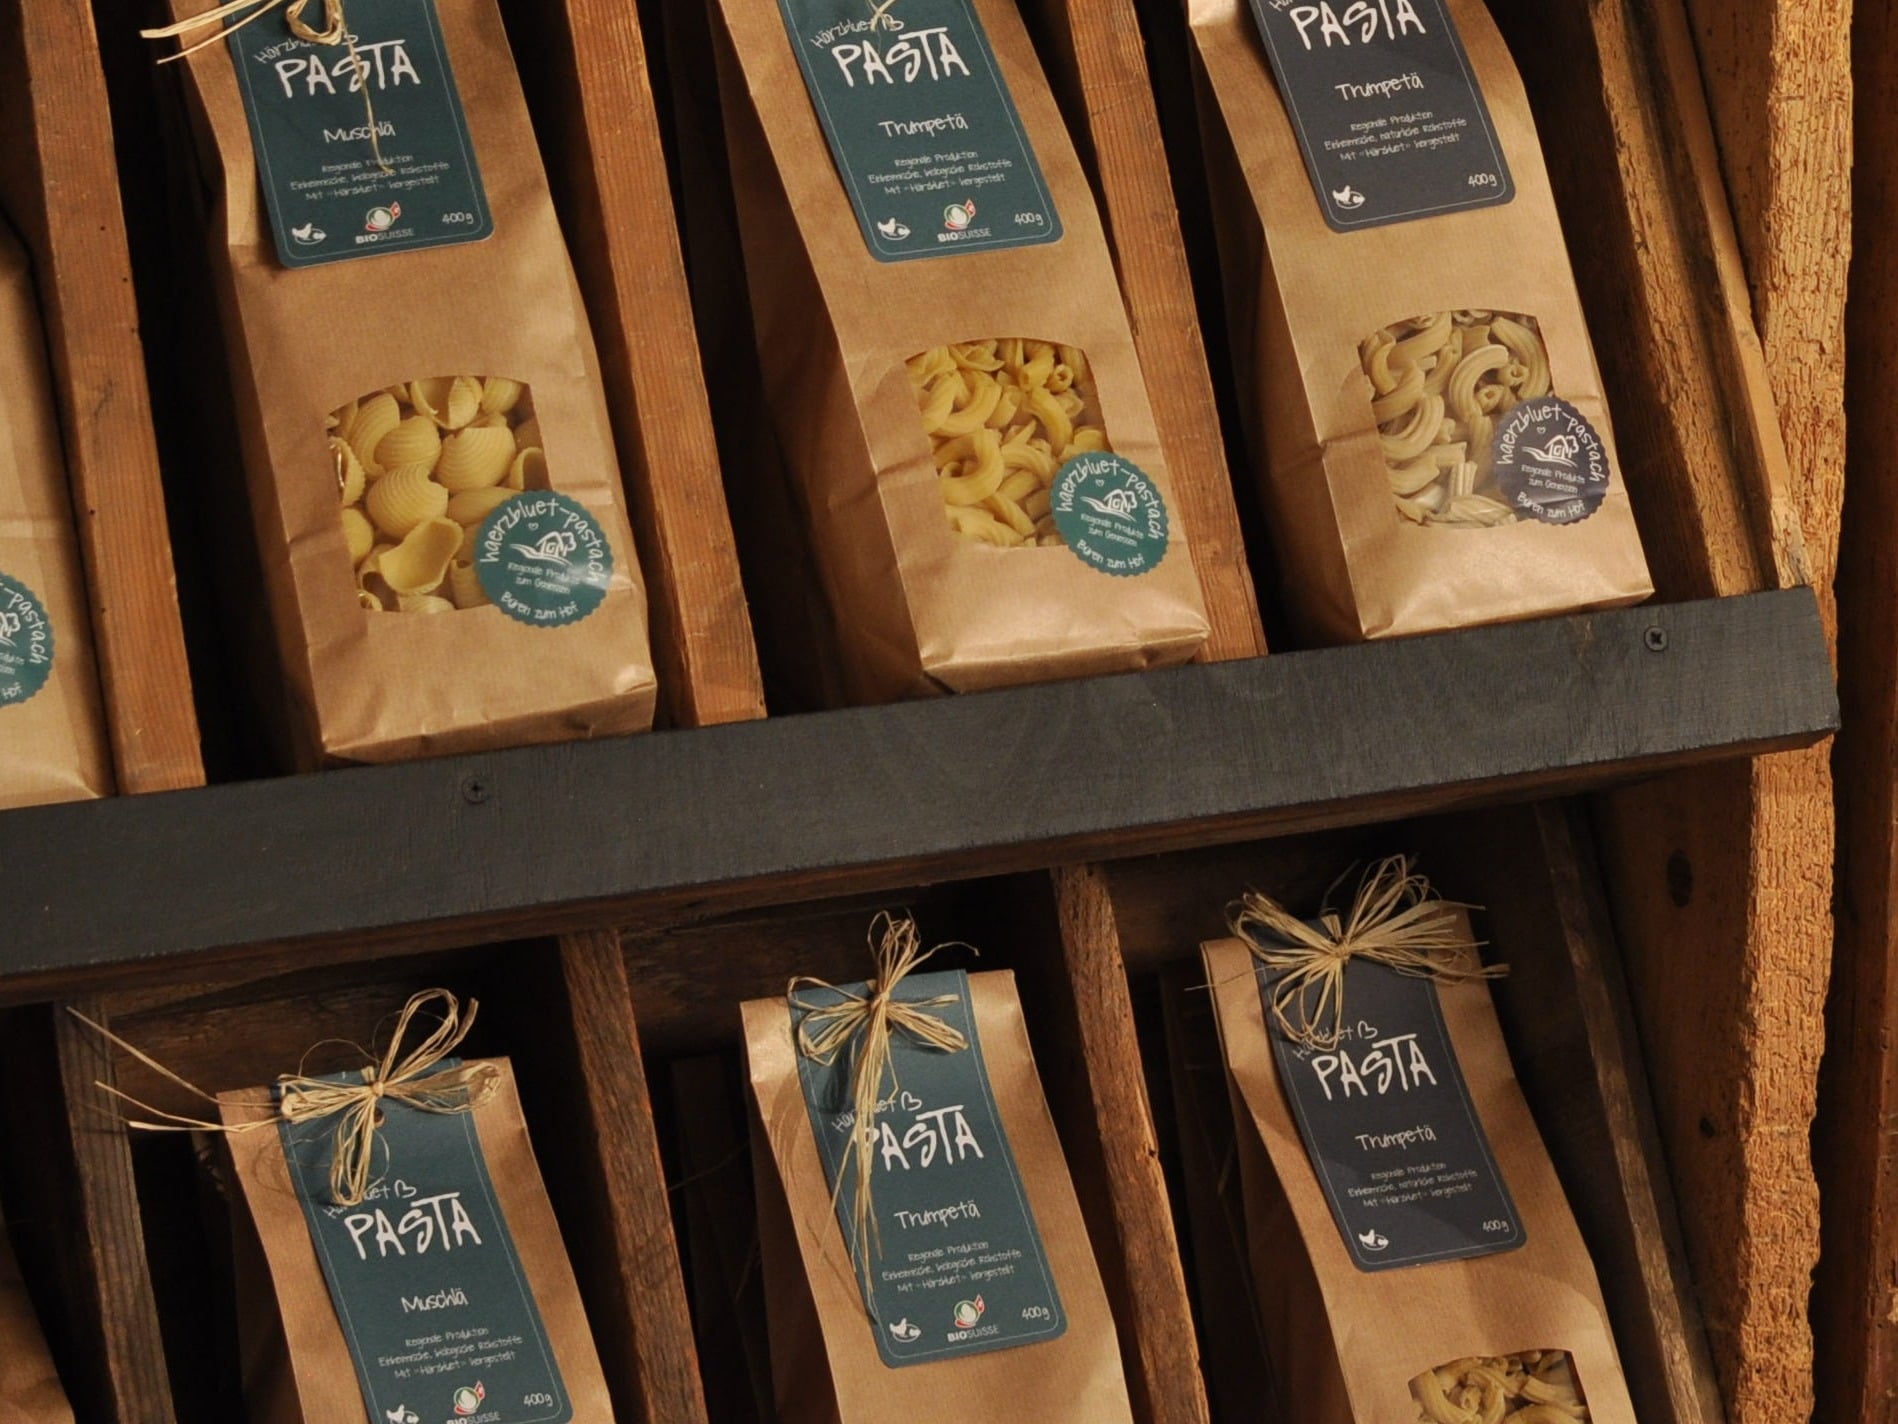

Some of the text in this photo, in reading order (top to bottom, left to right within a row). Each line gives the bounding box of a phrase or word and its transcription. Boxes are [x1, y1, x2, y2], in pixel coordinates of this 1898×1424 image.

[275, 39, 421, 98] PASTA
[832, 27, 970, 87] PASTA
[1335, 72, 1424, 101] Trumpetä
[878, 114, 969, 137] Trumpetä
[1468, 173, 1497, 187] 400g
[442, 212, 474, 224] 400g
[1015, 212, 1043, 225] 400g
[355, 228, 416, 244] BIOSUISSE
[938, 228, 991, 242] BIOSUISSE
[1312, 1033, 1437, 1101] PASTA
[1355, 1125, 1437, 1151] Trumpetä
[344, 1192, 482, 1260] PASTA
[894, 1200, 981, 1229] Trumpetä
[401, 1287, 469, 1313] Muschlä
[948, 1326, 1000, 1343] BIOSUISSE
[524, 1393, 553, 1407] 400g
